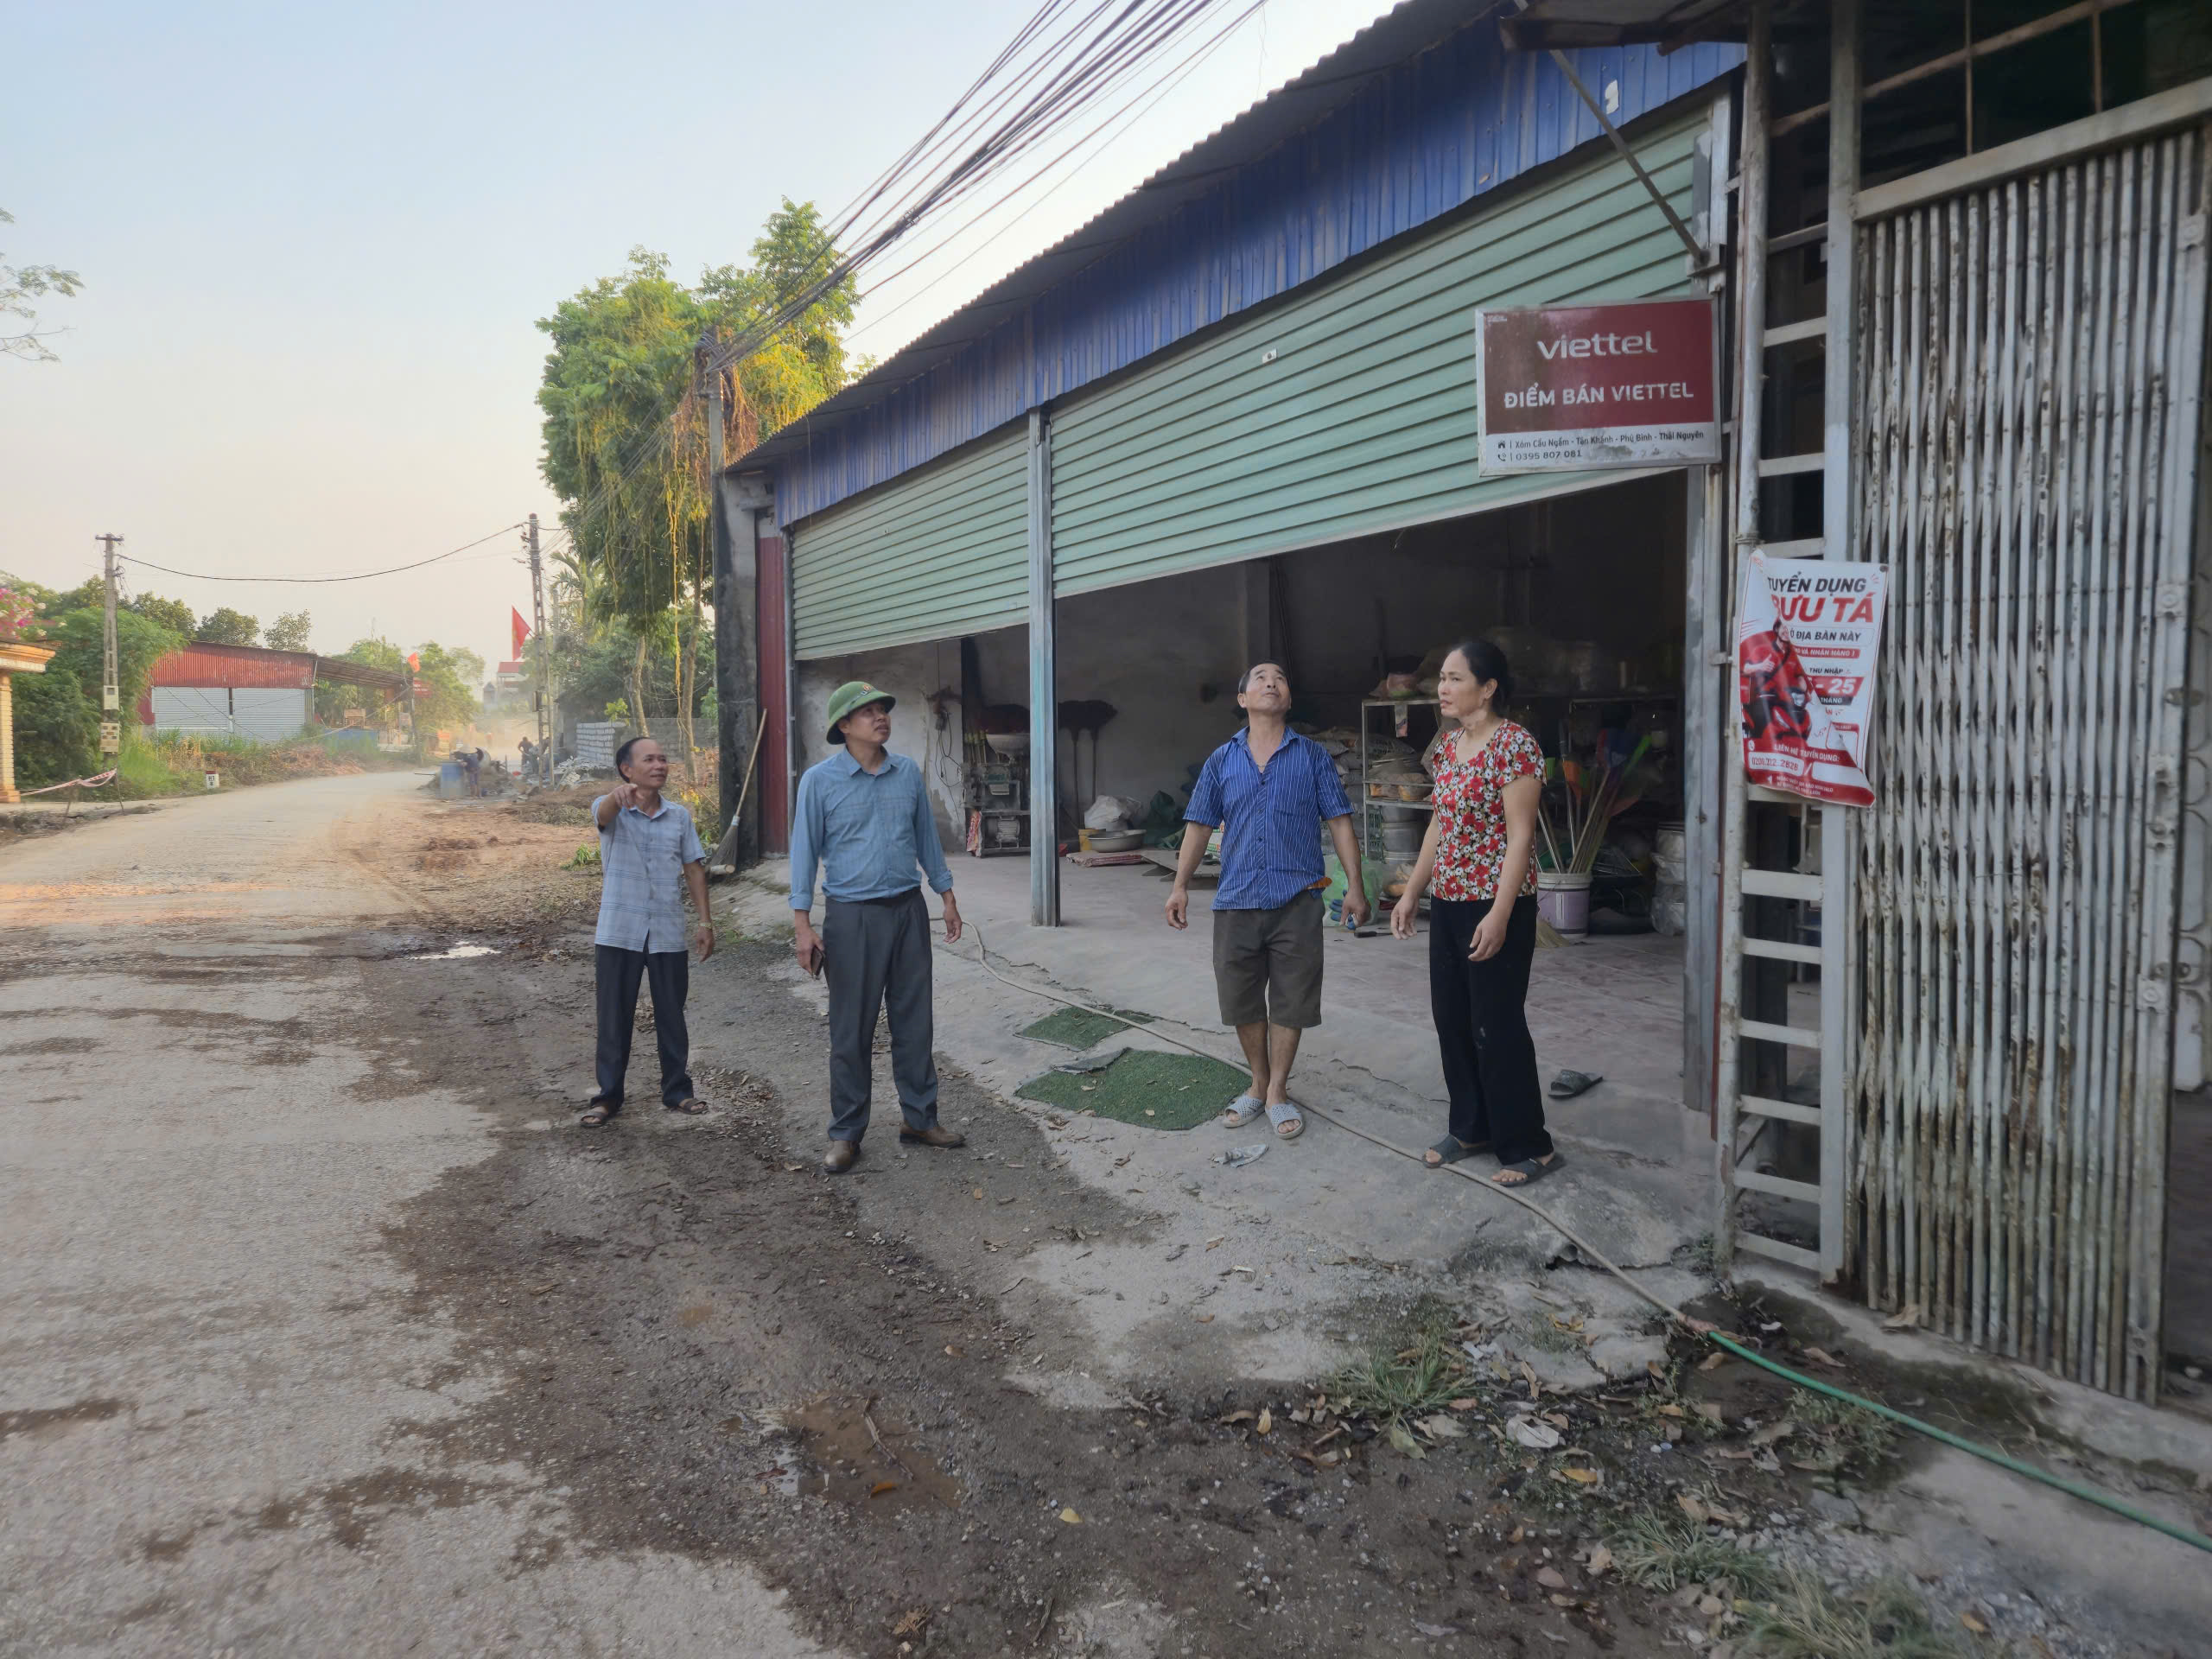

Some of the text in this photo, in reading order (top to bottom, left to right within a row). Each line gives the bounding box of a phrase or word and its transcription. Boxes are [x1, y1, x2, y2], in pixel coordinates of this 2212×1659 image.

[1537, 331, 1658, 360] viettel
[1504, 382, 1694, 409] ĐIỂM BÁN VIETTEL
[1516, 440, 1531, 448] Xóm
[1676, 430, 1704, 442] Nguyên
[1516, 449, 1582, 461] 0395 807 081
[1815, 577, 1867, 597] DỤNG
[1833, 591, 1877, 623] TÁ
[1796, 631, 1812, 641] ĐỊA
[1815, 629, 1837, 640] BÀN
[1840, 630, 1861, 641] NÀY
[1828, 677, 1857, 694] 25
